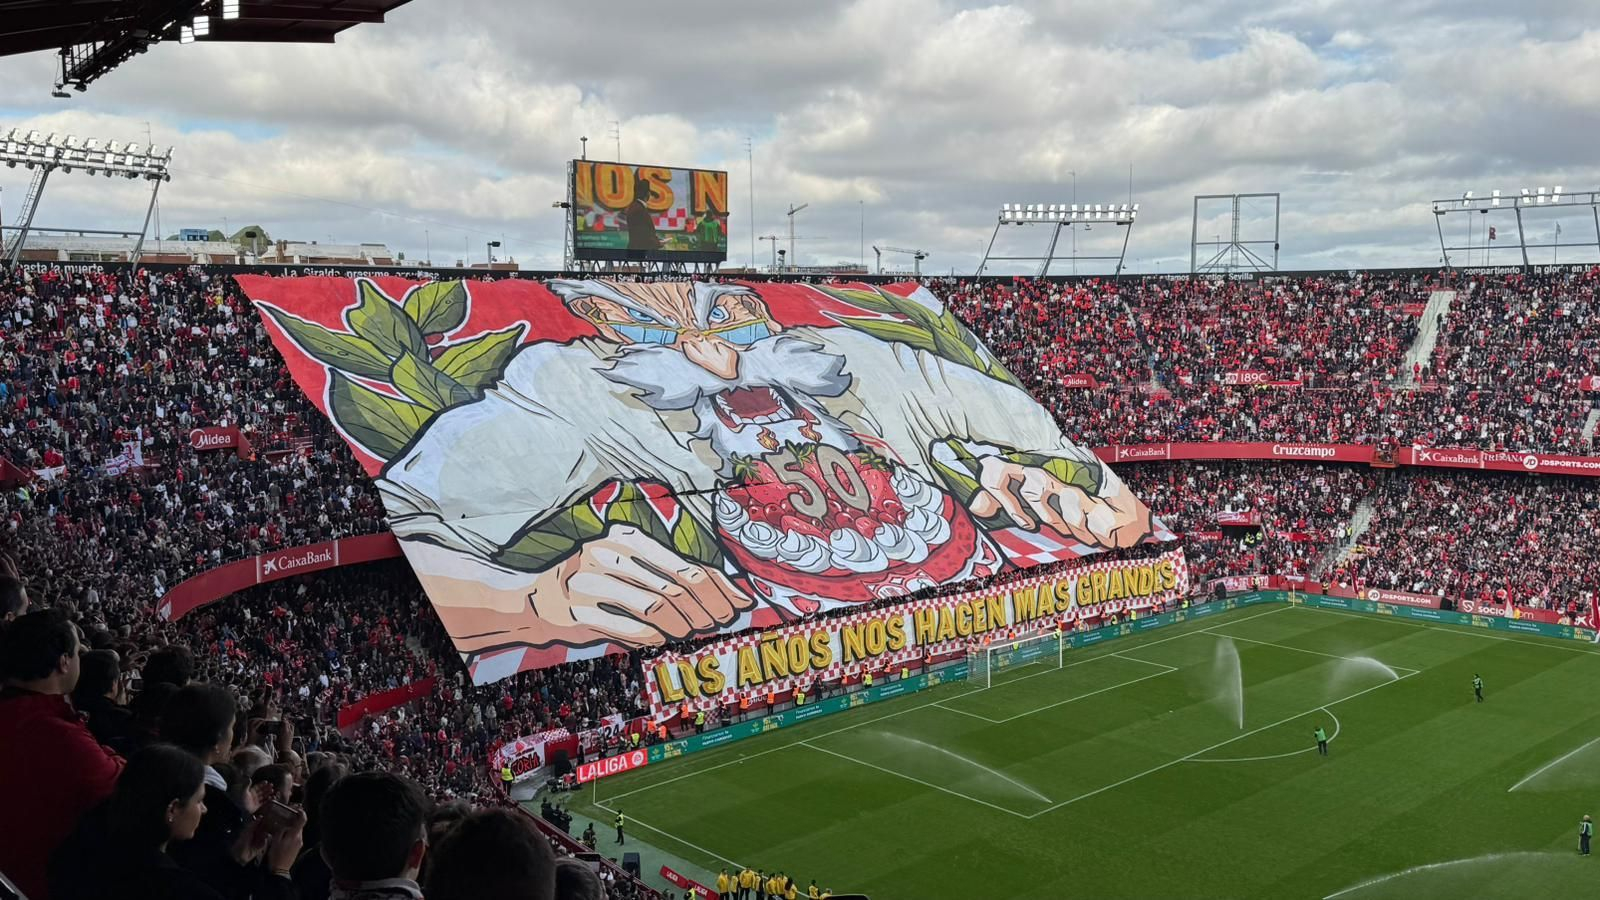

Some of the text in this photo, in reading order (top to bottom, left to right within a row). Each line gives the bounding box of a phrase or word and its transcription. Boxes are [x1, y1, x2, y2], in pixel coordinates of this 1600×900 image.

[1229, 272, 1254, 282] Sevilla
[1464, 266, 1520, 276] compartiendo
[1534, 265, 1541, 273] la
[199, 434, 231, 448] Midea
[1129, 447, 1166, 457] CaixaBank
[1273, 444, 1336, 458] Cruzcampo
[1432, 452, 1479, 464] CaixaBank
[1540, 460, 1600, 469] JDSPORTS.COM
[762, 441, 870, 520] 50
[279, 548, 332, 570] CaixaBank
[1381, 593, 1431, 605] JDSPORTS.COM
[655, 558, 1177, 704] LOS AÑOS NOS HACEN MAS GRANDES
[579, 755, 628, 781] LALIGA
